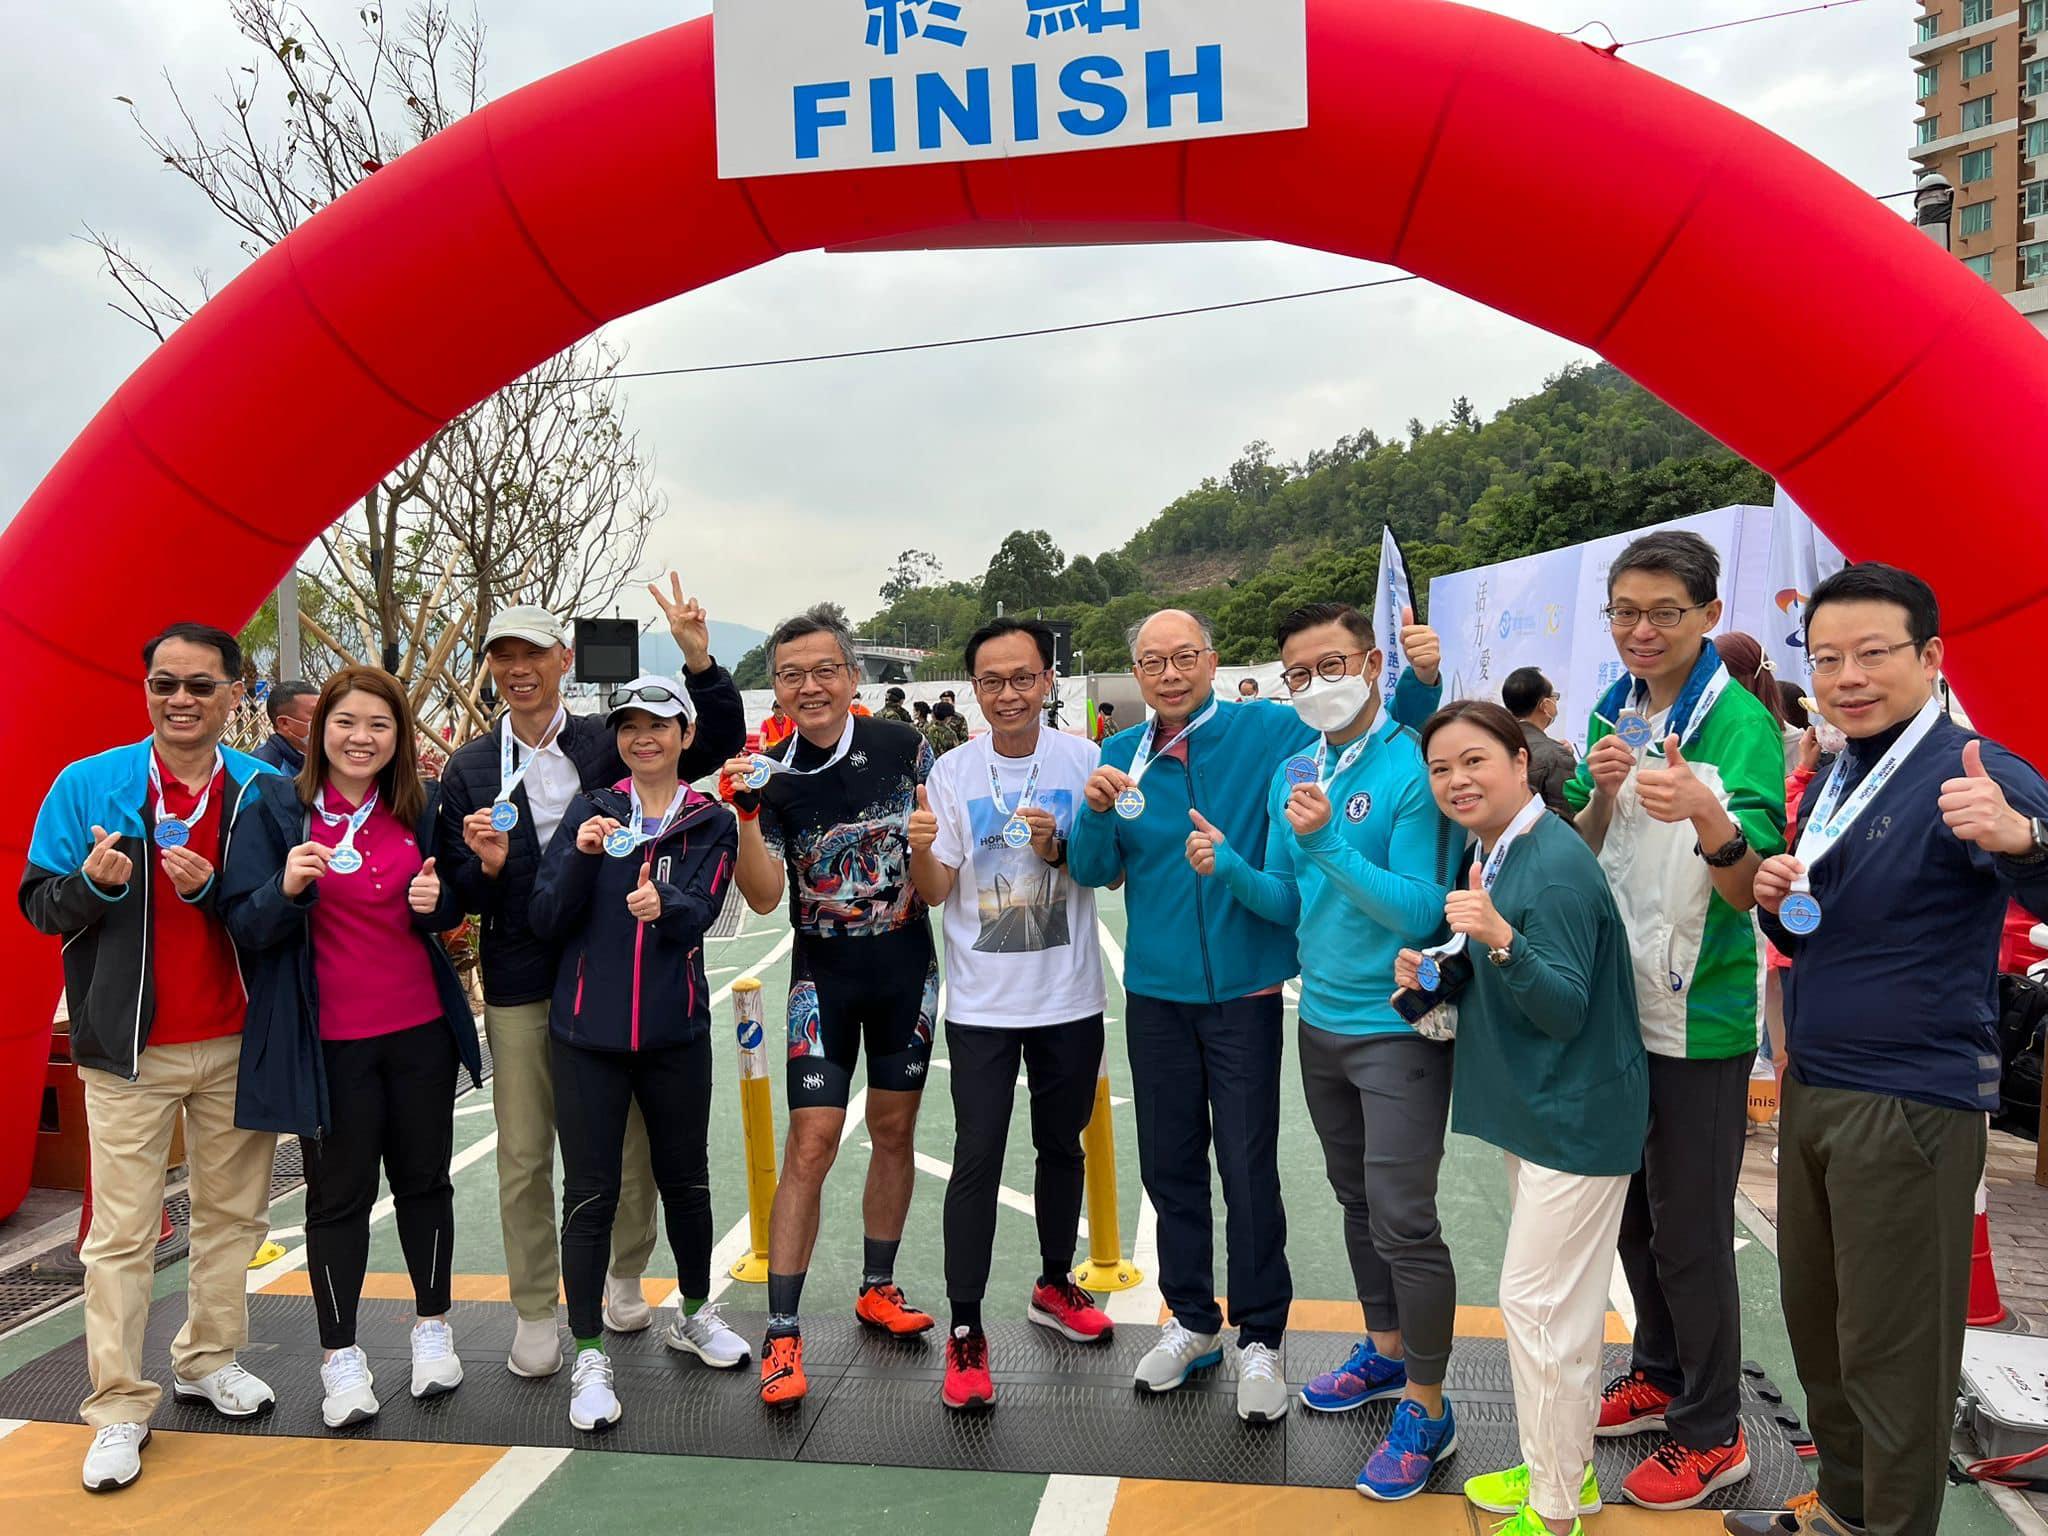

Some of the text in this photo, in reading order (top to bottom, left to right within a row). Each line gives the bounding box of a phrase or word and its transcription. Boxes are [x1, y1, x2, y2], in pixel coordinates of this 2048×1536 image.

[793, 44, 1223, 160] FINISH
[980, 834, 1005, 846] HOP
[1749, 1095, 1776, 1107] inis
